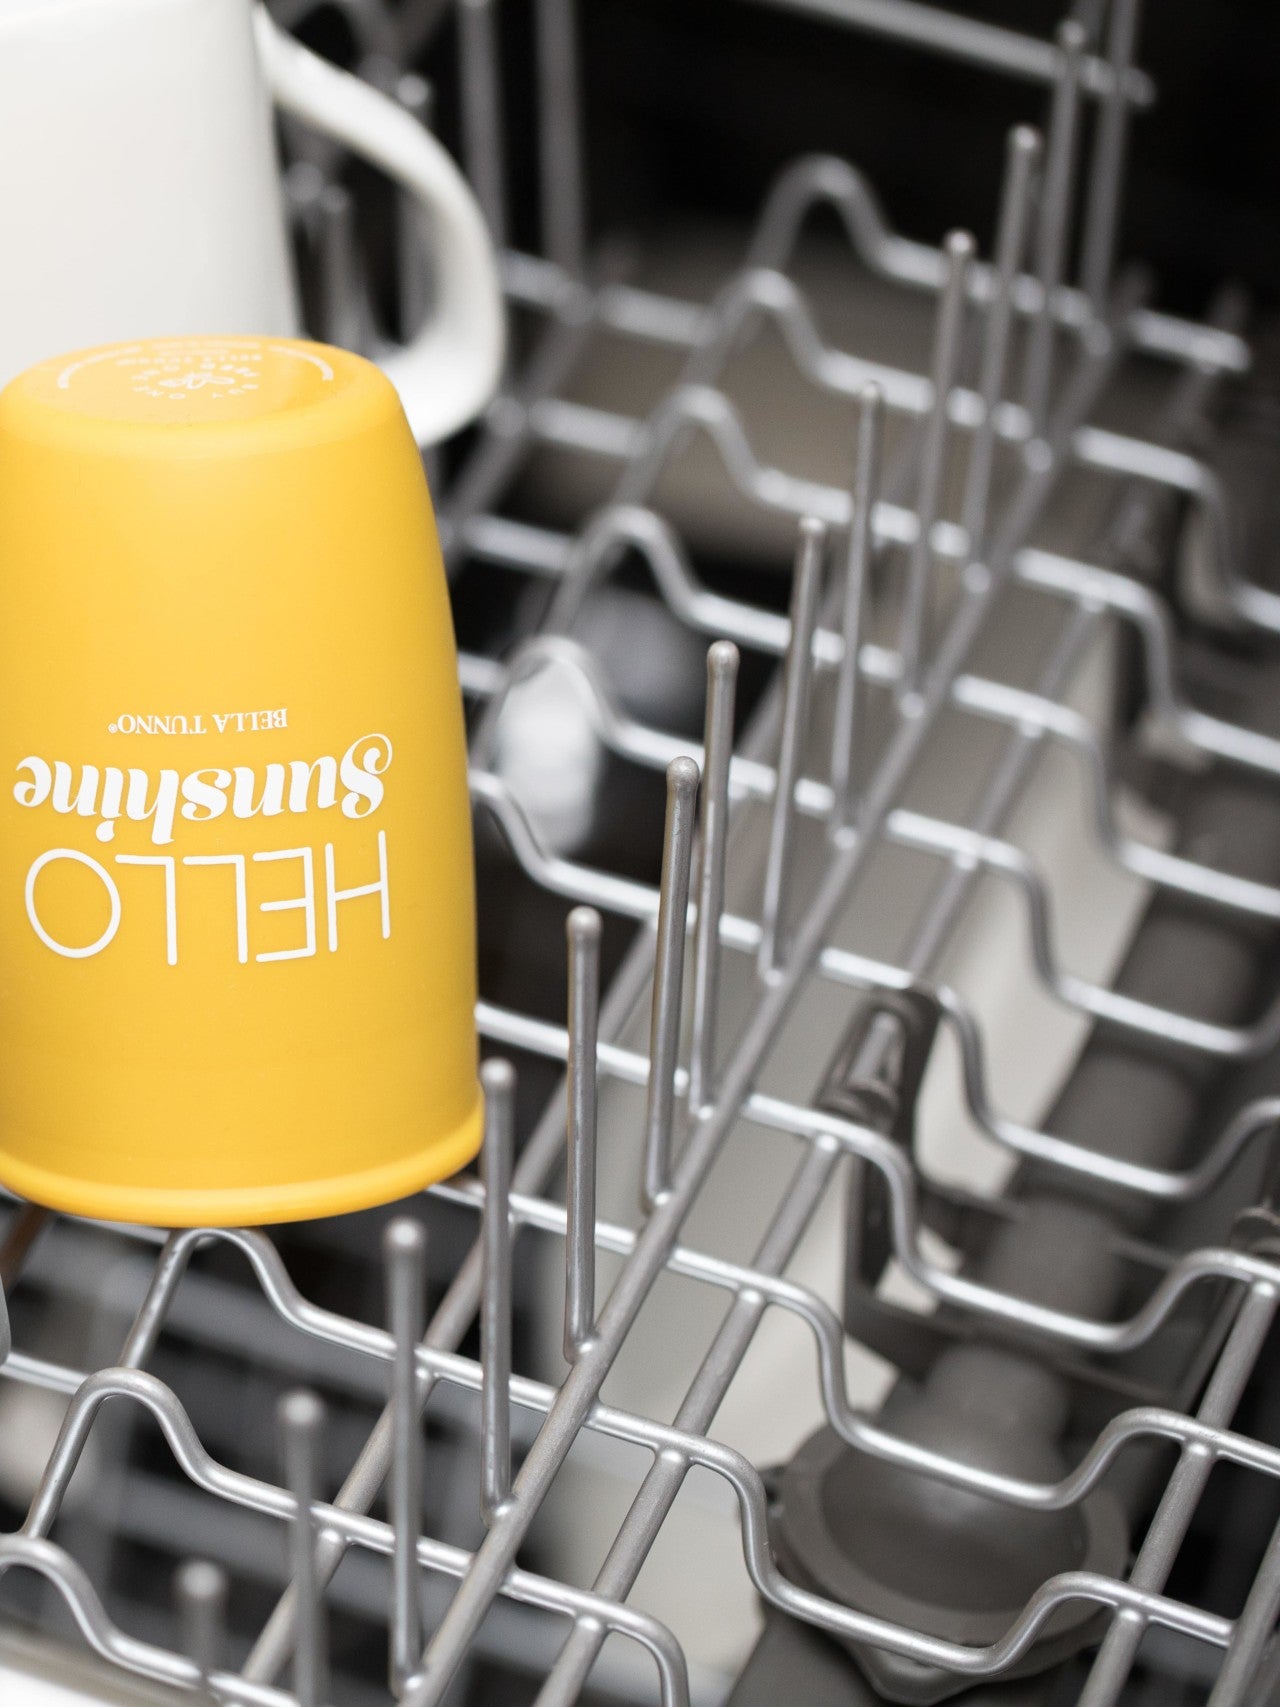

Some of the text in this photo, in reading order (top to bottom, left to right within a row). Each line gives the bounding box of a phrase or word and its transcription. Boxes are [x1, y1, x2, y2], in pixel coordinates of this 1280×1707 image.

[211, 707, 288, 735] BELLA
[13, 733, 393, 846] Sunshine
[24, 830, 391, 966] HELLO
